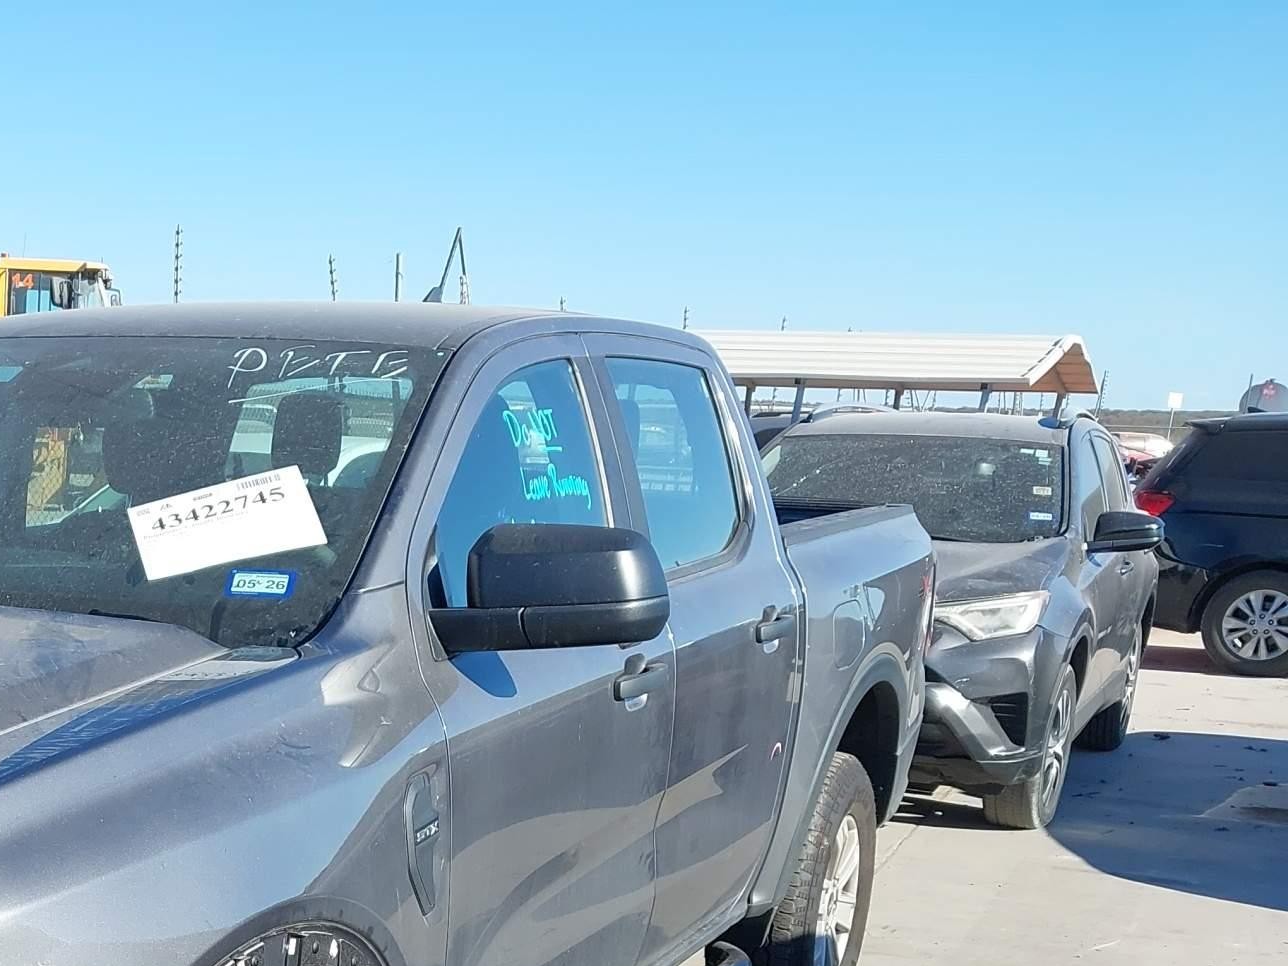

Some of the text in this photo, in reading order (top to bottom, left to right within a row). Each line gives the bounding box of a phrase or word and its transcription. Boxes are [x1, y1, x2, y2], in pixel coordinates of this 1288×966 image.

[227, 345, 409, 389] PETE
[151, 486, 286, 531] 43422745
[234, 579, 286, 590] 05 26
